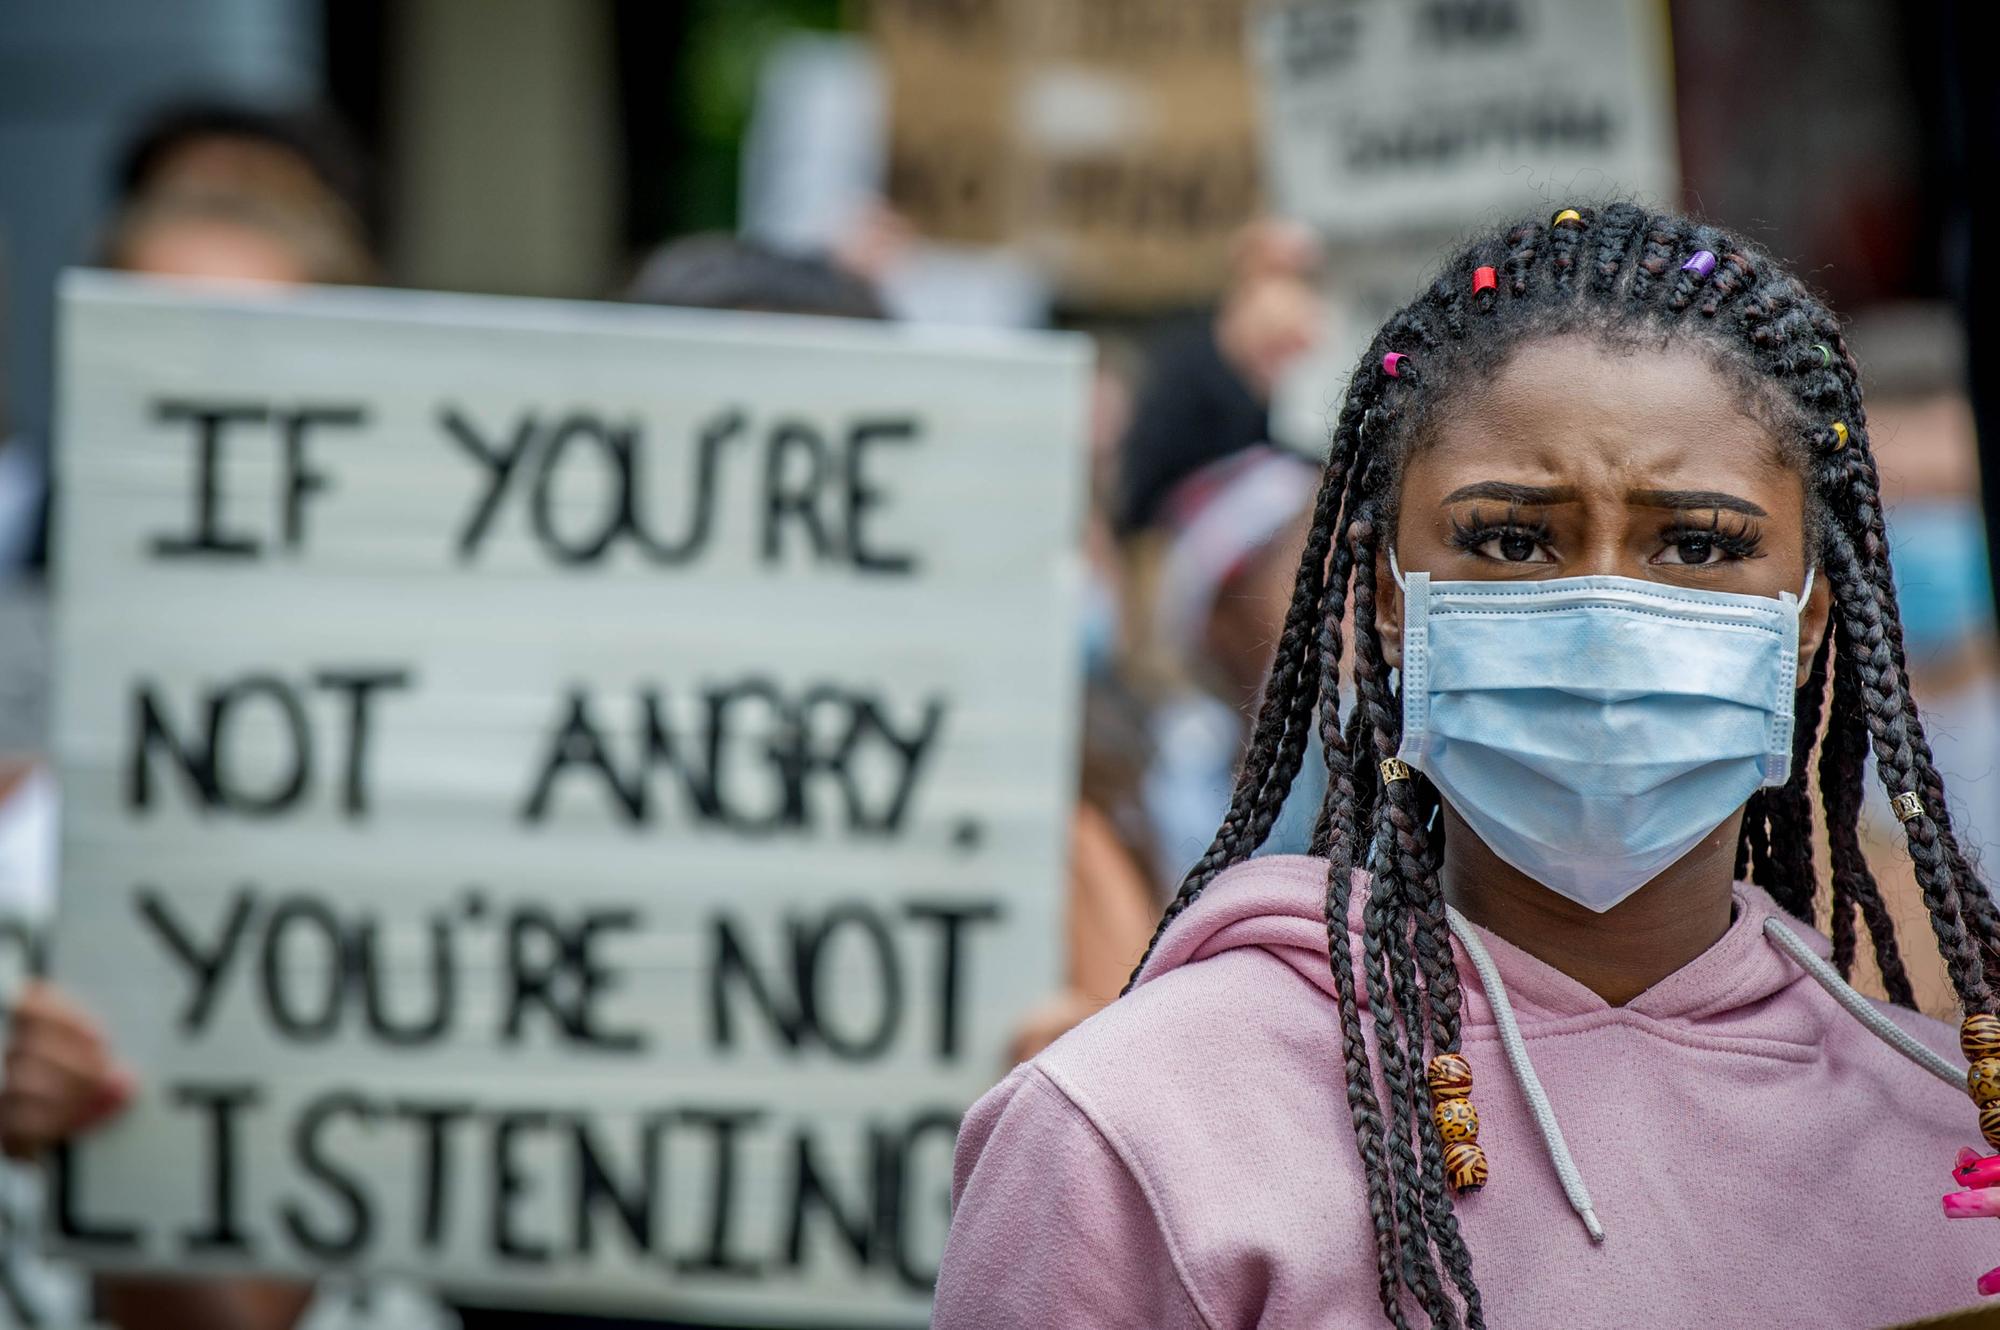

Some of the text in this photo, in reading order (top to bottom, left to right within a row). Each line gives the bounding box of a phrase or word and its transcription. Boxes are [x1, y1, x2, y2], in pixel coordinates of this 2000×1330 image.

[148, 398, 366, 560] IF
[122, 671, 980, 846] NOT ANGRY.
[132, 887, 1000, 1064] YOU'RE NOT
